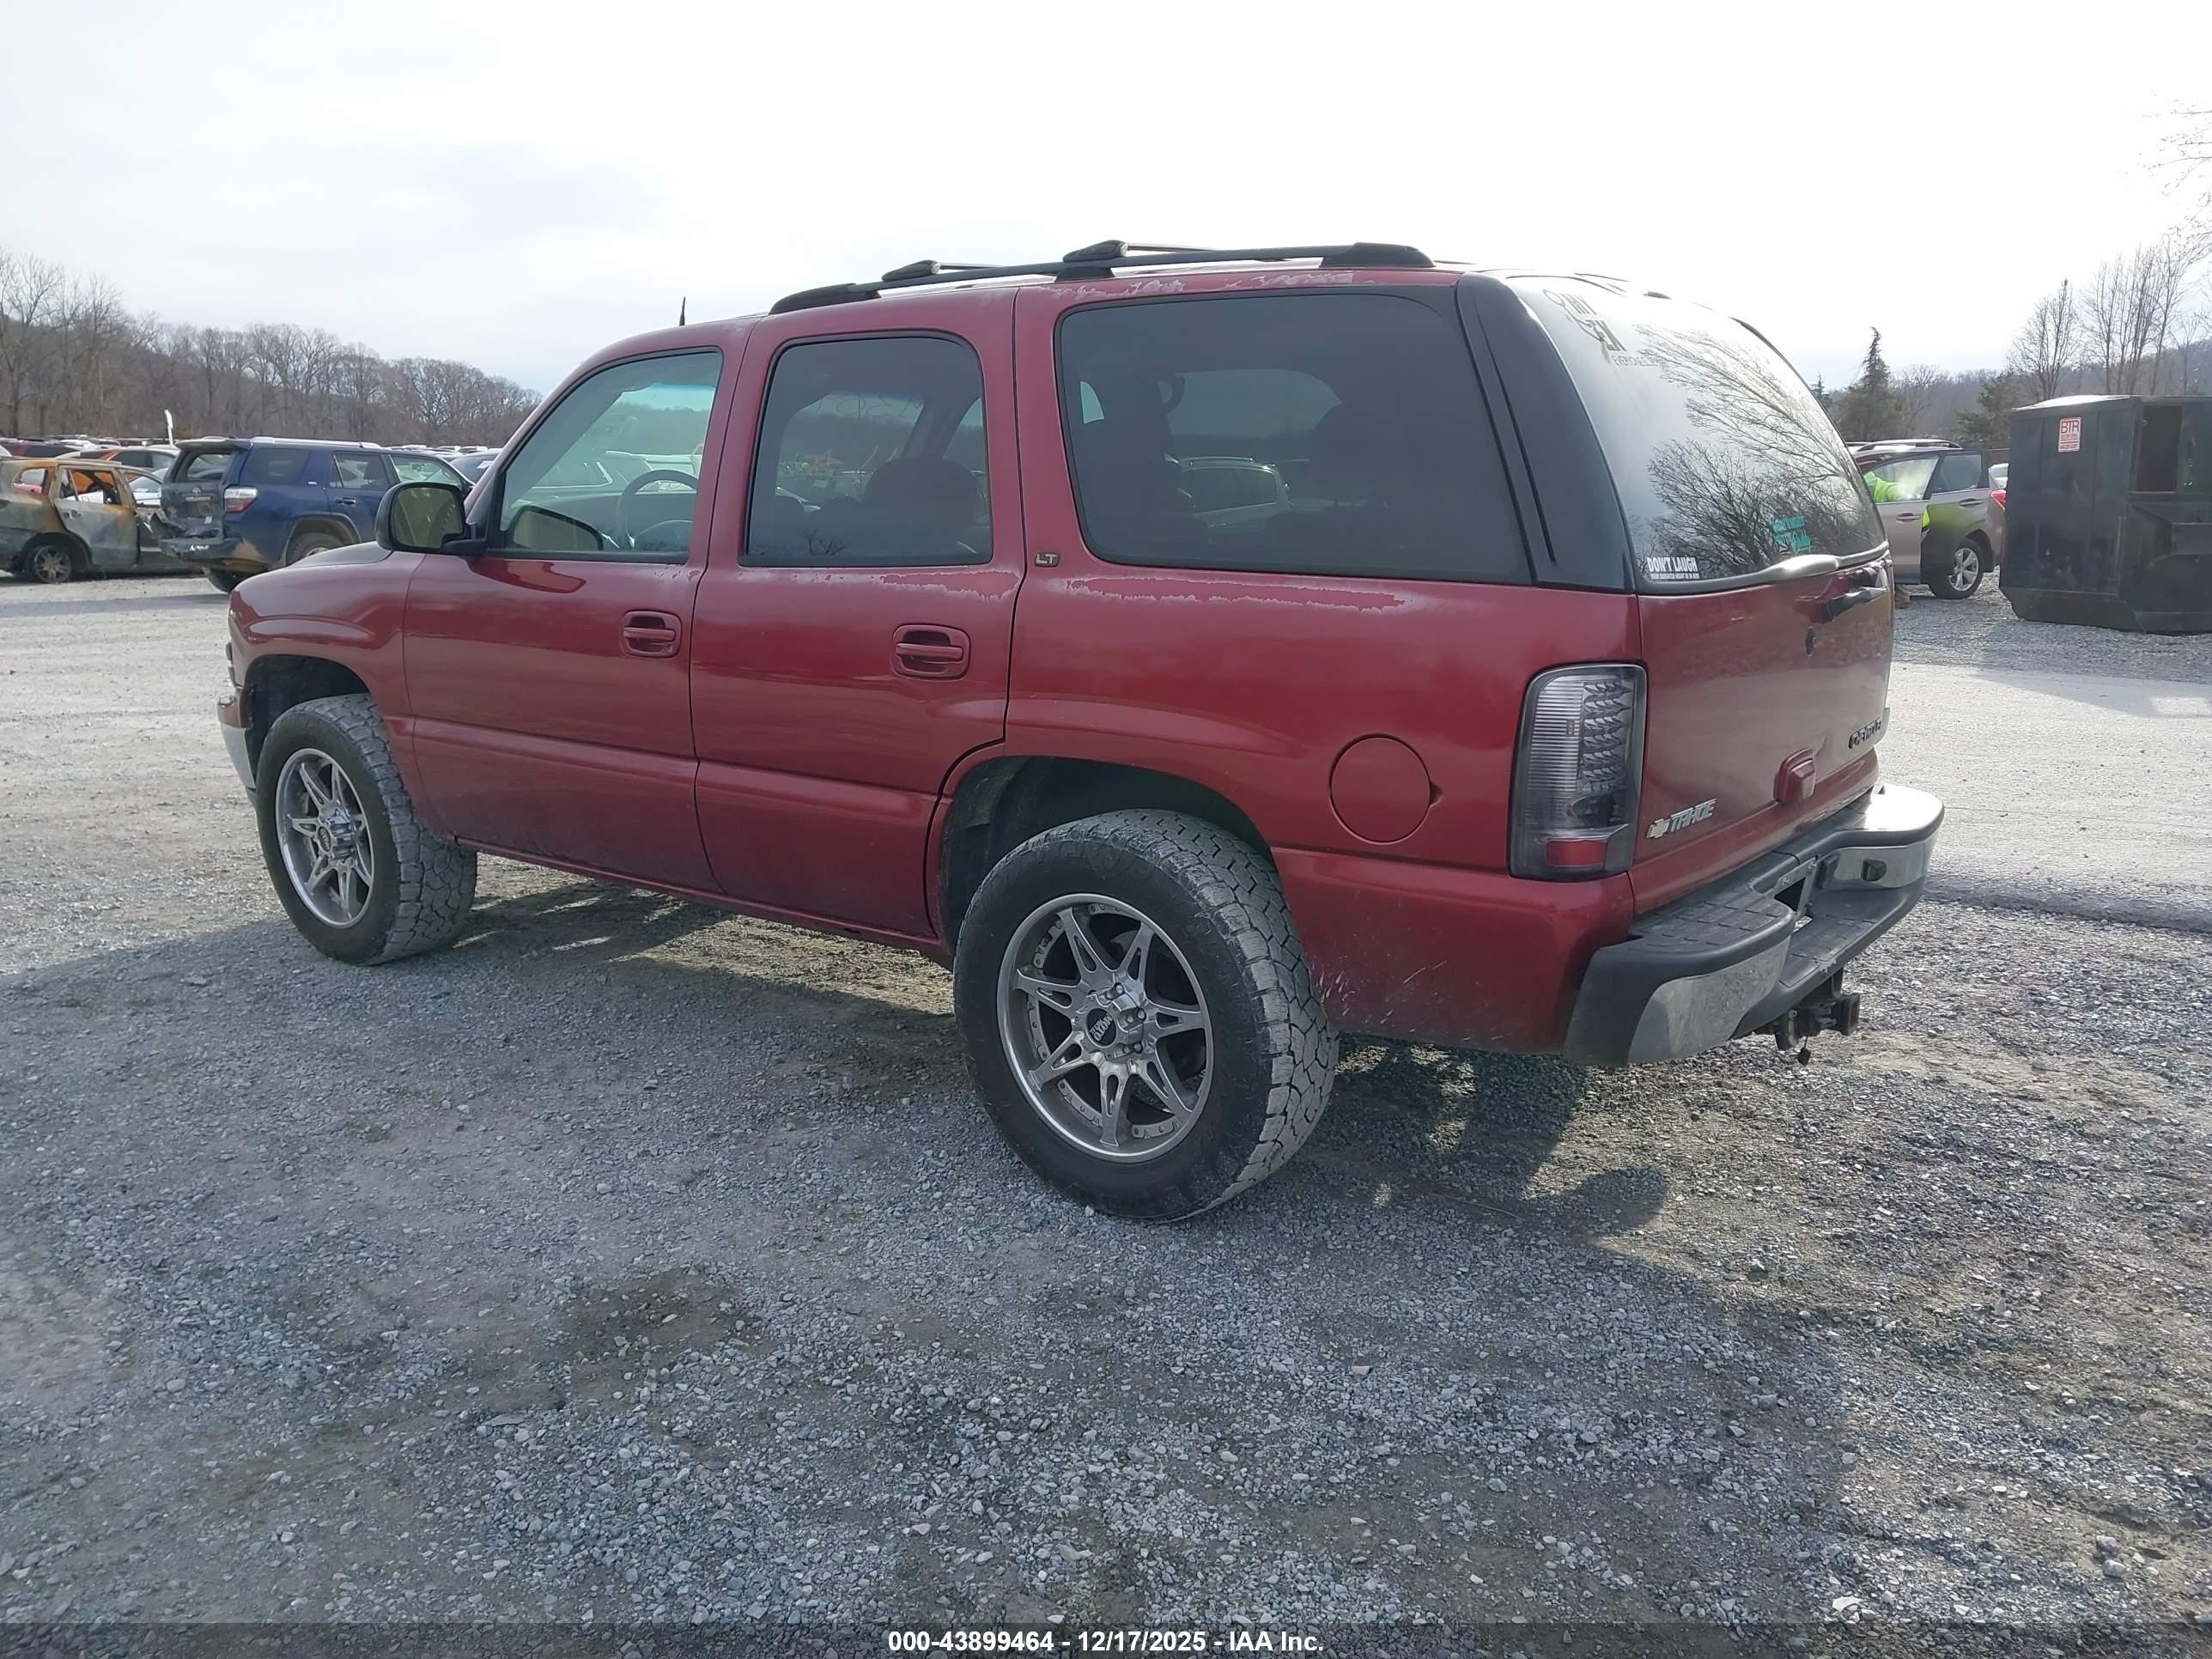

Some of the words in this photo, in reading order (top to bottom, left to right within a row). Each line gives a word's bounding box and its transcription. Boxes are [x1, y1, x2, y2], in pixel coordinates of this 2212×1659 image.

[2061, 420, 2079, 434] BTR
[1036, 553, 1058, 564] LT
[1646, 556, 1673, 572] DON'T
[1672, 556, 1698, 572] LAUGH
